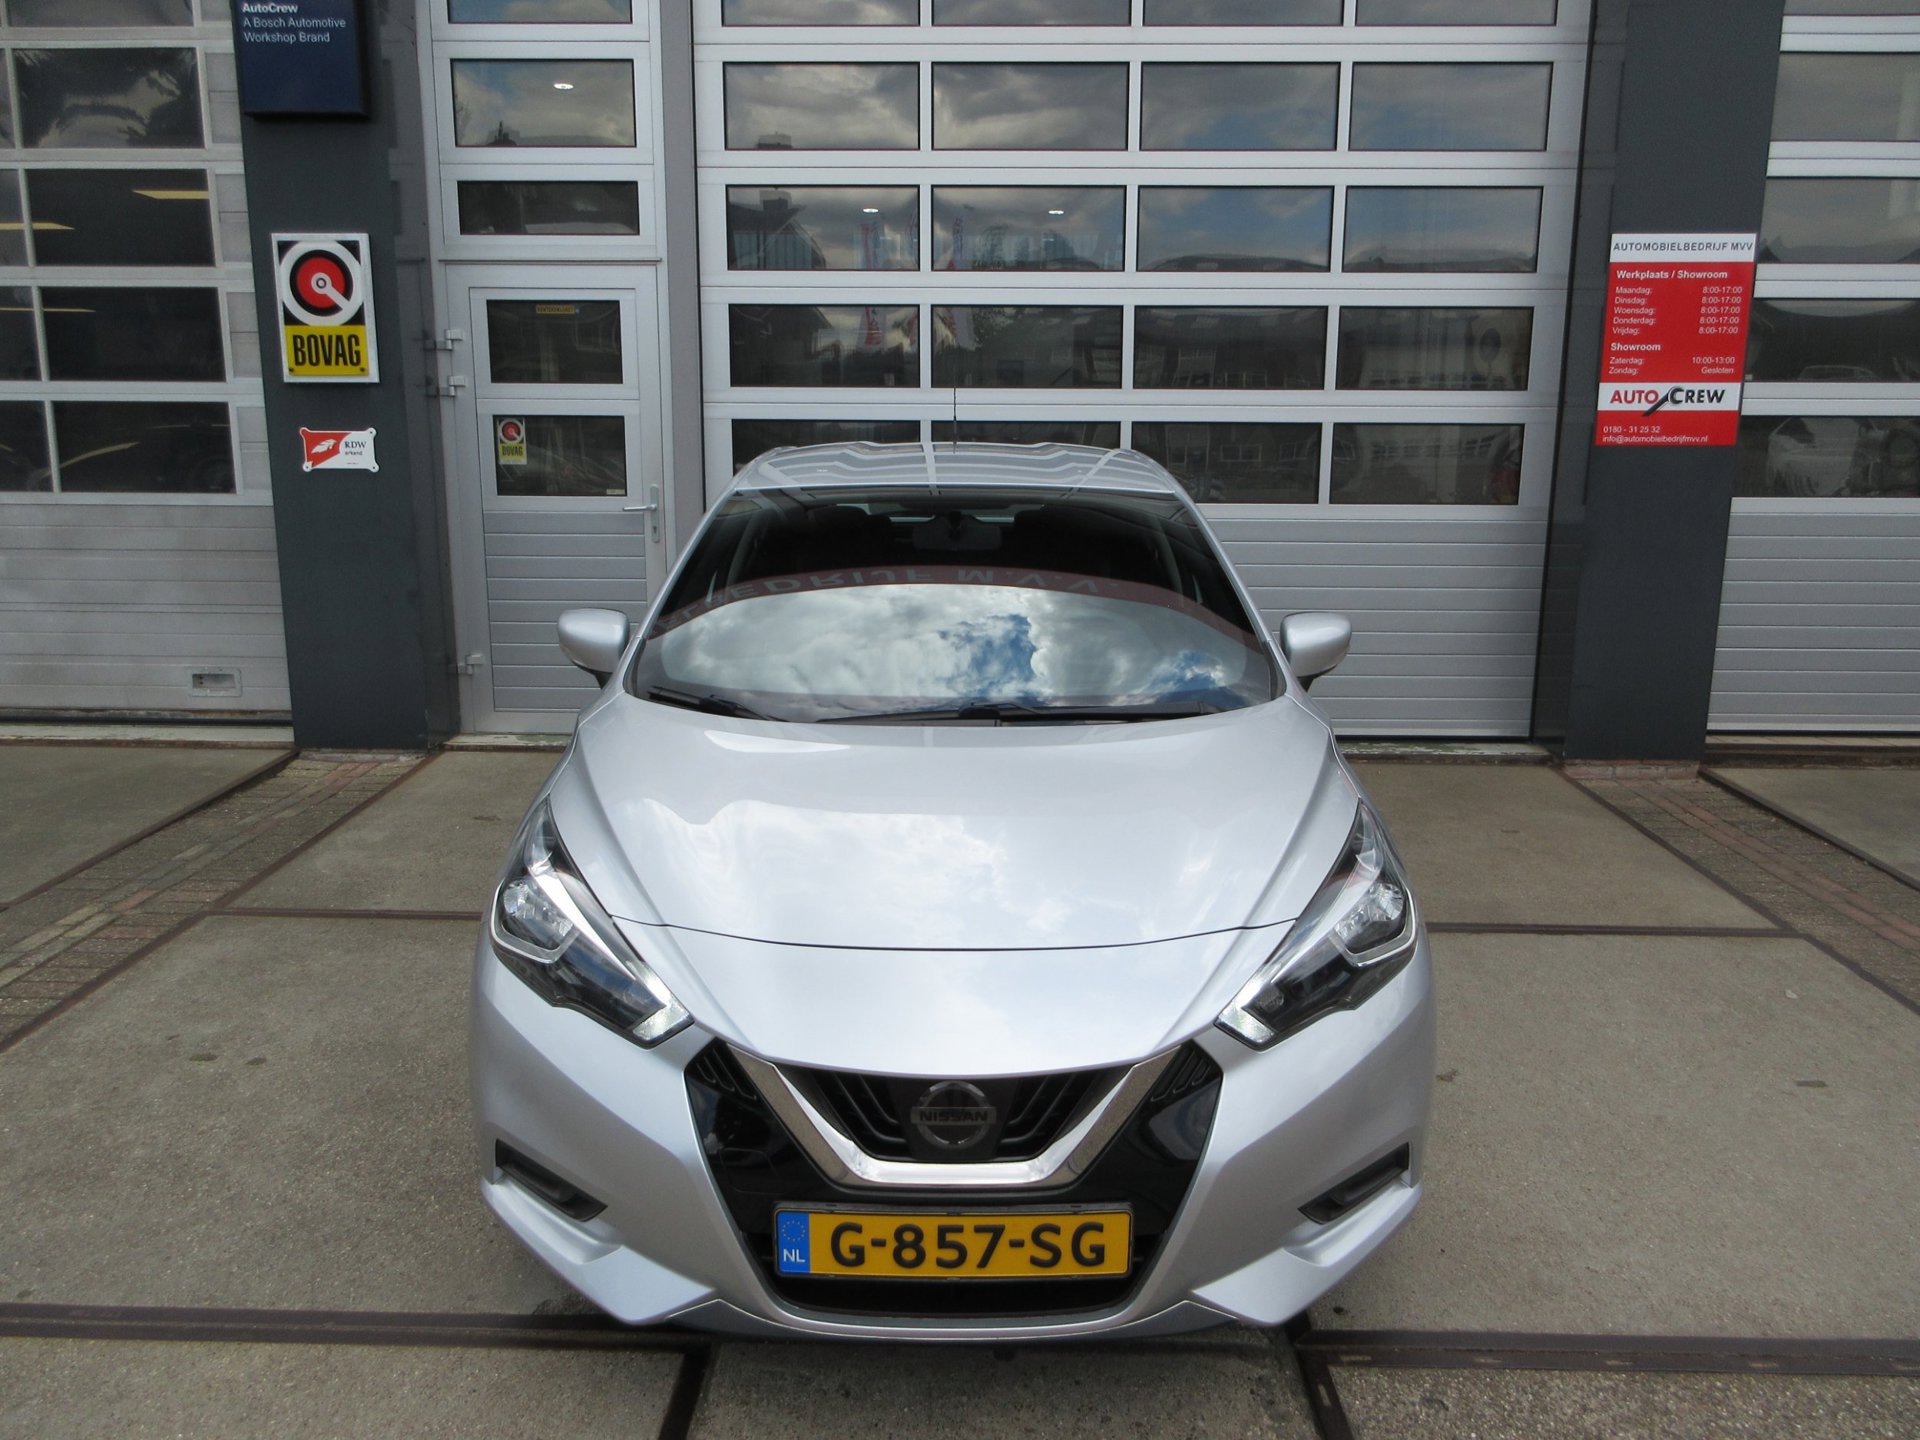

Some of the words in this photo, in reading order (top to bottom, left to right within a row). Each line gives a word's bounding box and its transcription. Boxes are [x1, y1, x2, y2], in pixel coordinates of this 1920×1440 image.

[242, 2, 298, 13] AutoCrew
[243, 18, 252, 28] A
[254, 17, 286, 28] Bosch
[288, 17, 346, 28] Automotive
[244, 32, 297, 44] Workshop
[299, 32, 330, 42] Brand
[1613, 242, 1728, 251] AUTOMOBIELBEDRIJF
[1730, 242, 1753, 251] MVV
[1616, 270, 1669, 280] Werkplaats
[1677, 270, 1728, 279] Showroom
[292, 333, 362, 367] BOVAG
[1610, 342, 1661, 351] Showroom
[1701, 366, 1735, 374] Gesloten
[1610, 389, 1659, 404] AUTO
[1669, 386, 1726, 405] CREW
[1603, 426, 1622, 434] 0180
[344, 441, 367, 449] RDW
[919, 1109, 988, 1122] NISSAN
[830, 1221, 1106, 1269] G-857-SG
[783, 1248, 806, 1263] NL
